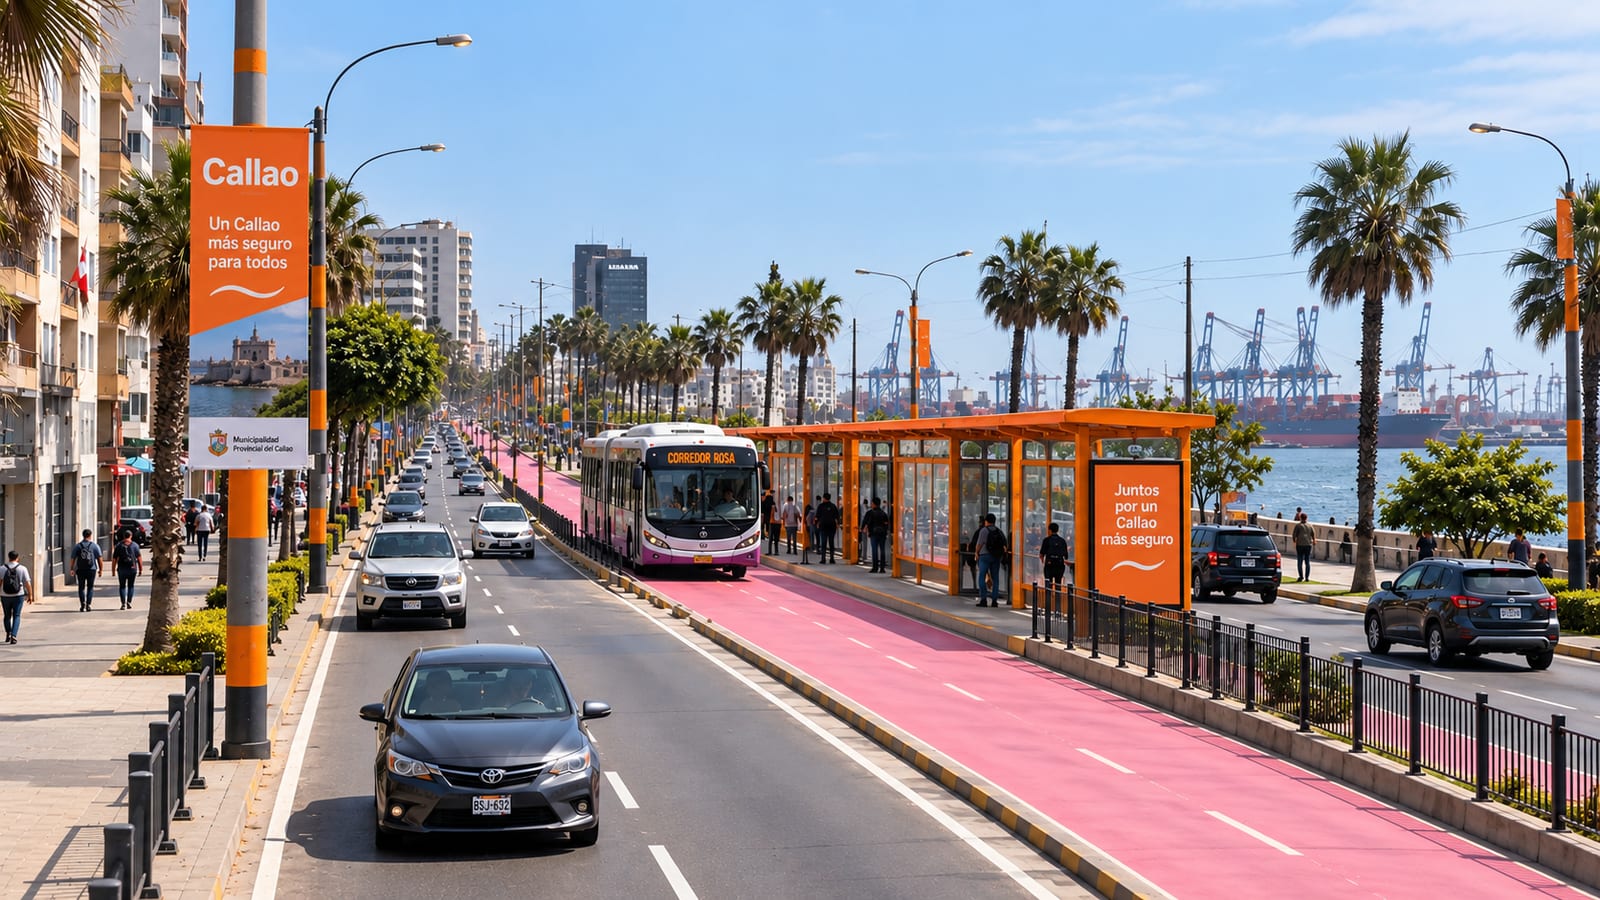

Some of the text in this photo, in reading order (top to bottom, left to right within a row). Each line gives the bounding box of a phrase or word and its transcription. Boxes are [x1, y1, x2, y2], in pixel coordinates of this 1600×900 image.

[202, 157, 299, 187] Callao
[209, 216, 280, 231] Un Callao
[208, 235, 292, 254] más seguro
[208, 255, 288, 271] para todos
[233, 436, 279, 444] Municipalidad
[667, 452, 736, 464] CORREDOR ROSA
[1114, 483, 1160, 496] Juntos
[1115, 502, 1158, 514] por un
[1116, 516, 1157, 529] Callao
[1101, 532, 1174, 548] más seguro
